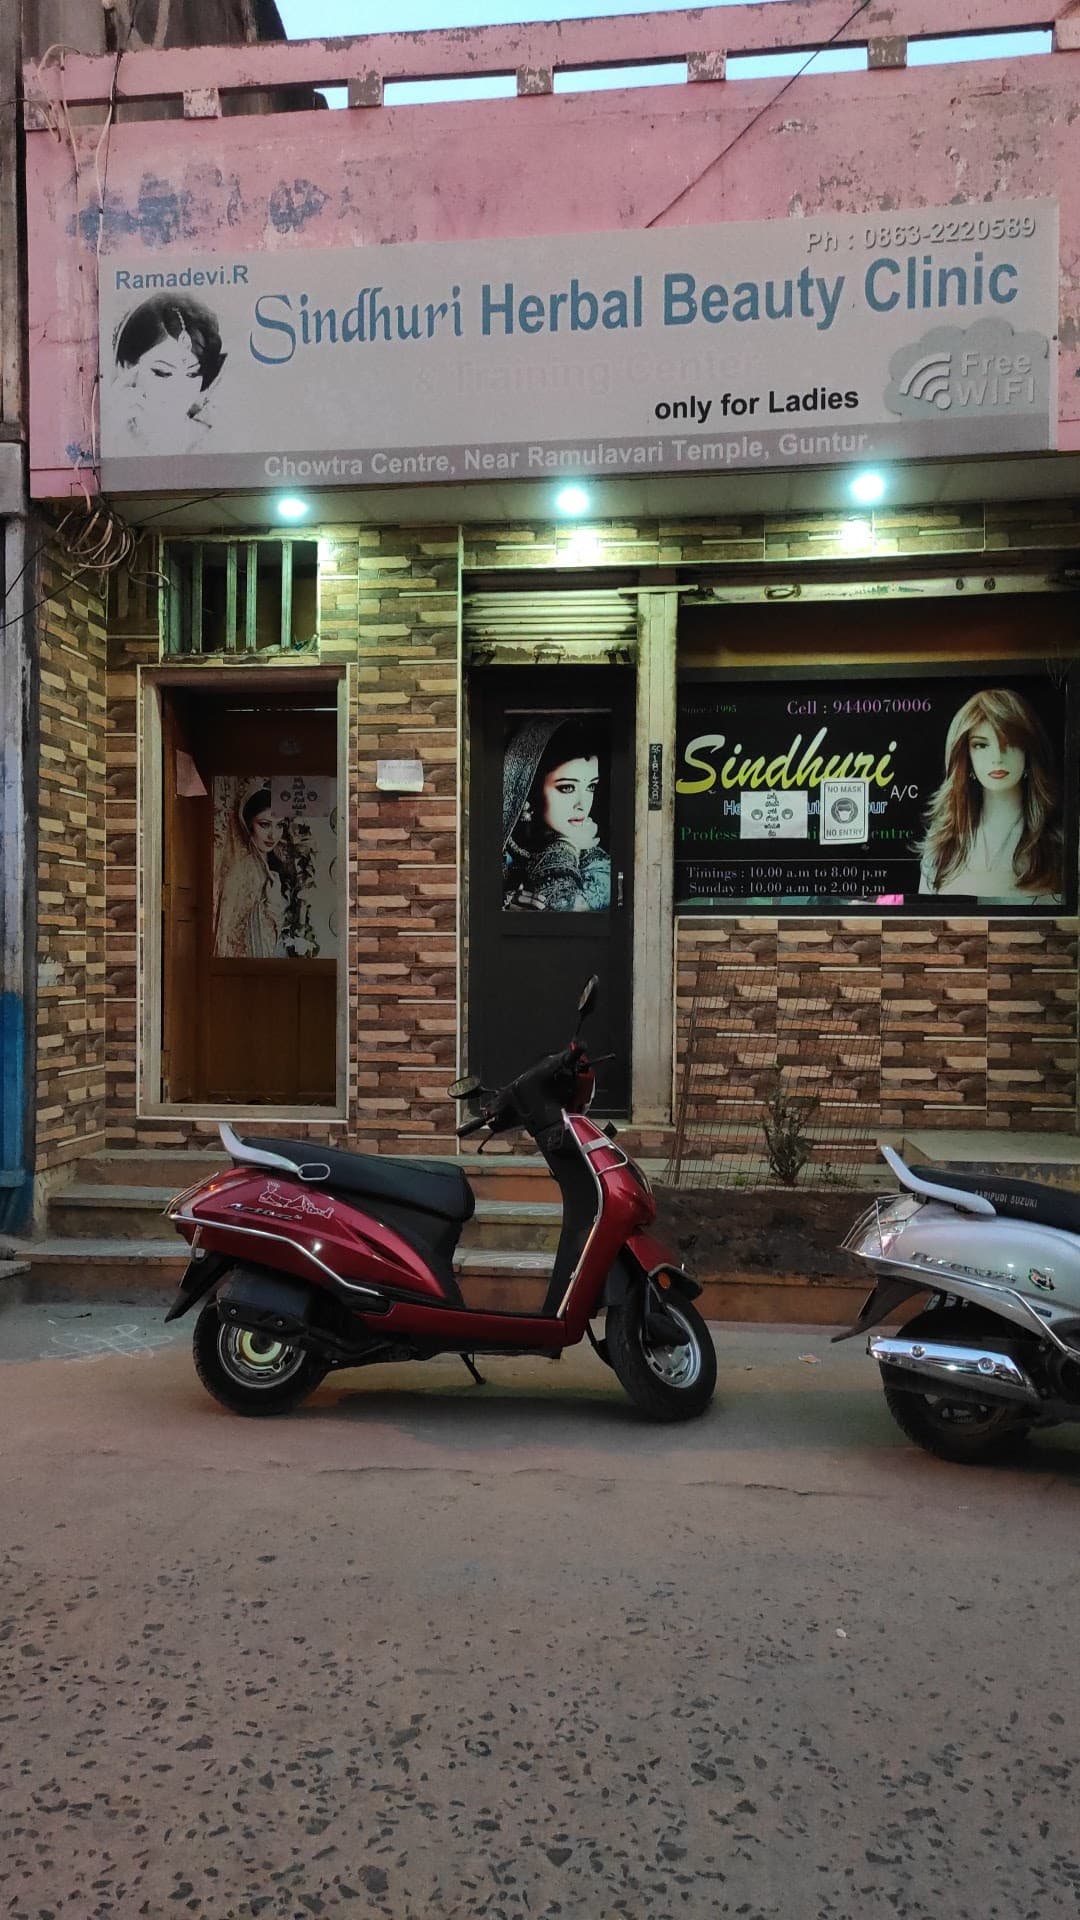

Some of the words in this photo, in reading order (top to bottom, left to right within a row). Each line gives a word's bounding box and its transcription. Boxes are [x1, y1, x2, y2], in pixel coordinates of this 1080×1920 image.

[806, 230, 838, 253] Ph
[864, 215, 1036, 249] 0863-2220589
[115, 265, 249, 290] Ramadevi.R
[249, 286, 464, 364] Sindhuri
[481, 276, 643, 335] Herbal
[663, 266, 846, 330] Beauty
[864, 251, 1019, 312] Clinic
[961, 352, 1032, 377] Free
[654, 395, 712, 423] only
[721, 394, 760, 416] for
[769, 386, 859, 413] Ladies
[264, 456, 363, 477] Chowtra
[371, 453, 456, 474] Centre,
[464, 449, 519, 470] Near
[528, 440, 663, 467] Ramulavari
[672, 436, 770, 463] Temple,
[778, 432, 873, 456] Guntur.
[786, 700, 817, 715] Cell
[833, 699, 932, 714] 9440070006
[675, 727, 897, 794] Sindhuri
[827, 785, 839, 793] NO
[840, 785, 862, 793] MASK
[890, 784, 919, 802] A/C
[681, 827, 739, 840] Profess
[870, 827, 914, 839] entre
[826, 829, 837, 837] NO
[838, 828, 864, 837] ENTRY
[686, 865, 738, 881] Timings
[750, 866, 783, 878] 10.00
[786, 869, 810, 878] a.m
[814, 867, 828, 878] to
[831, 866, 857, 878] 8.00
[688, 881, 736, 897] Sunday
[749, 881, 782, 893] 10.00
[785, 884, 809, 893] a.m
[813, 882, 827, 893] to
[830, 881, 857, 893] 2.00
[861, 884, 886, 899] p.m
[1010, 1195, 1038, 1208] SUZUKI
